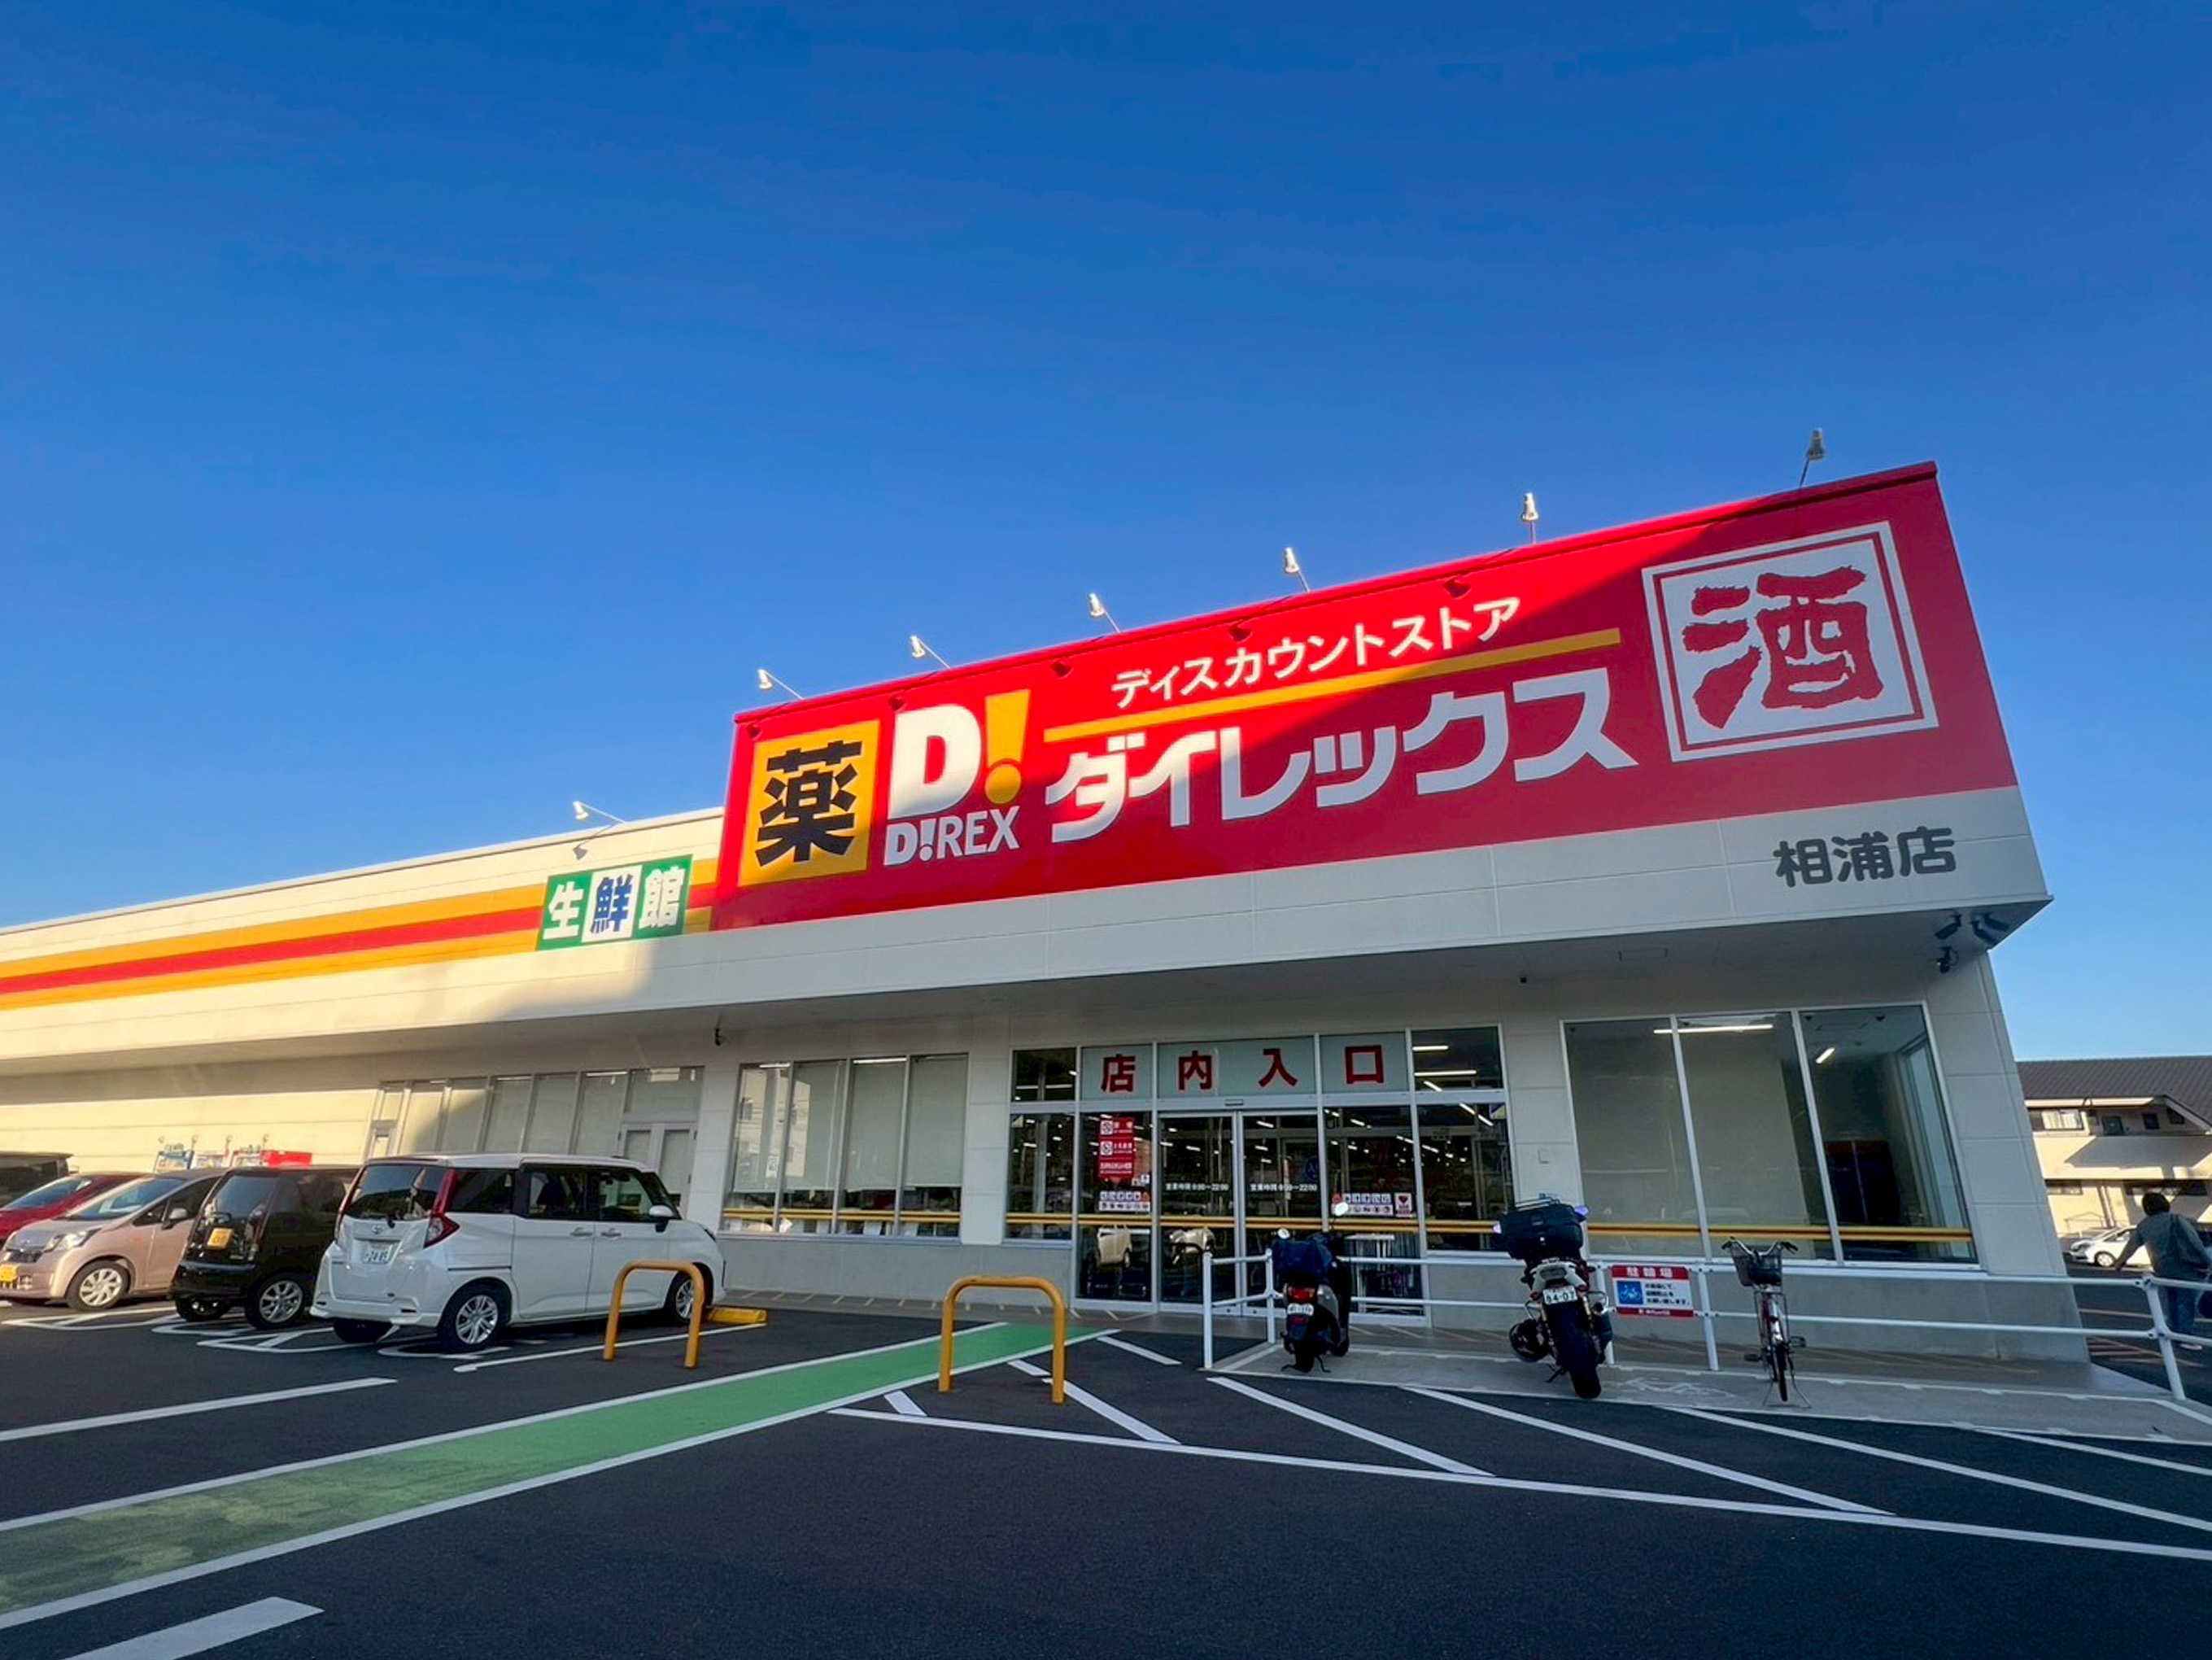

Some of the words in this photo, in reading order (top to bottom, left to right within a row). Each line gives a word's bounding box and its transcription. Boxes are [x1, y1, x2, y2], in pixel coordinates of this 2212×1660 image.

[1110, 596, 1521, 710] ディスカウントストア
[1681, 566, 1884, 729] 酒
[754, 740, 863, 867] 薬
[1045, 666, 1639, 844] ダイレックス
[542, 865, 686, 941] 生鮮館
[1773, 826, 1957, 888] 相浦店
